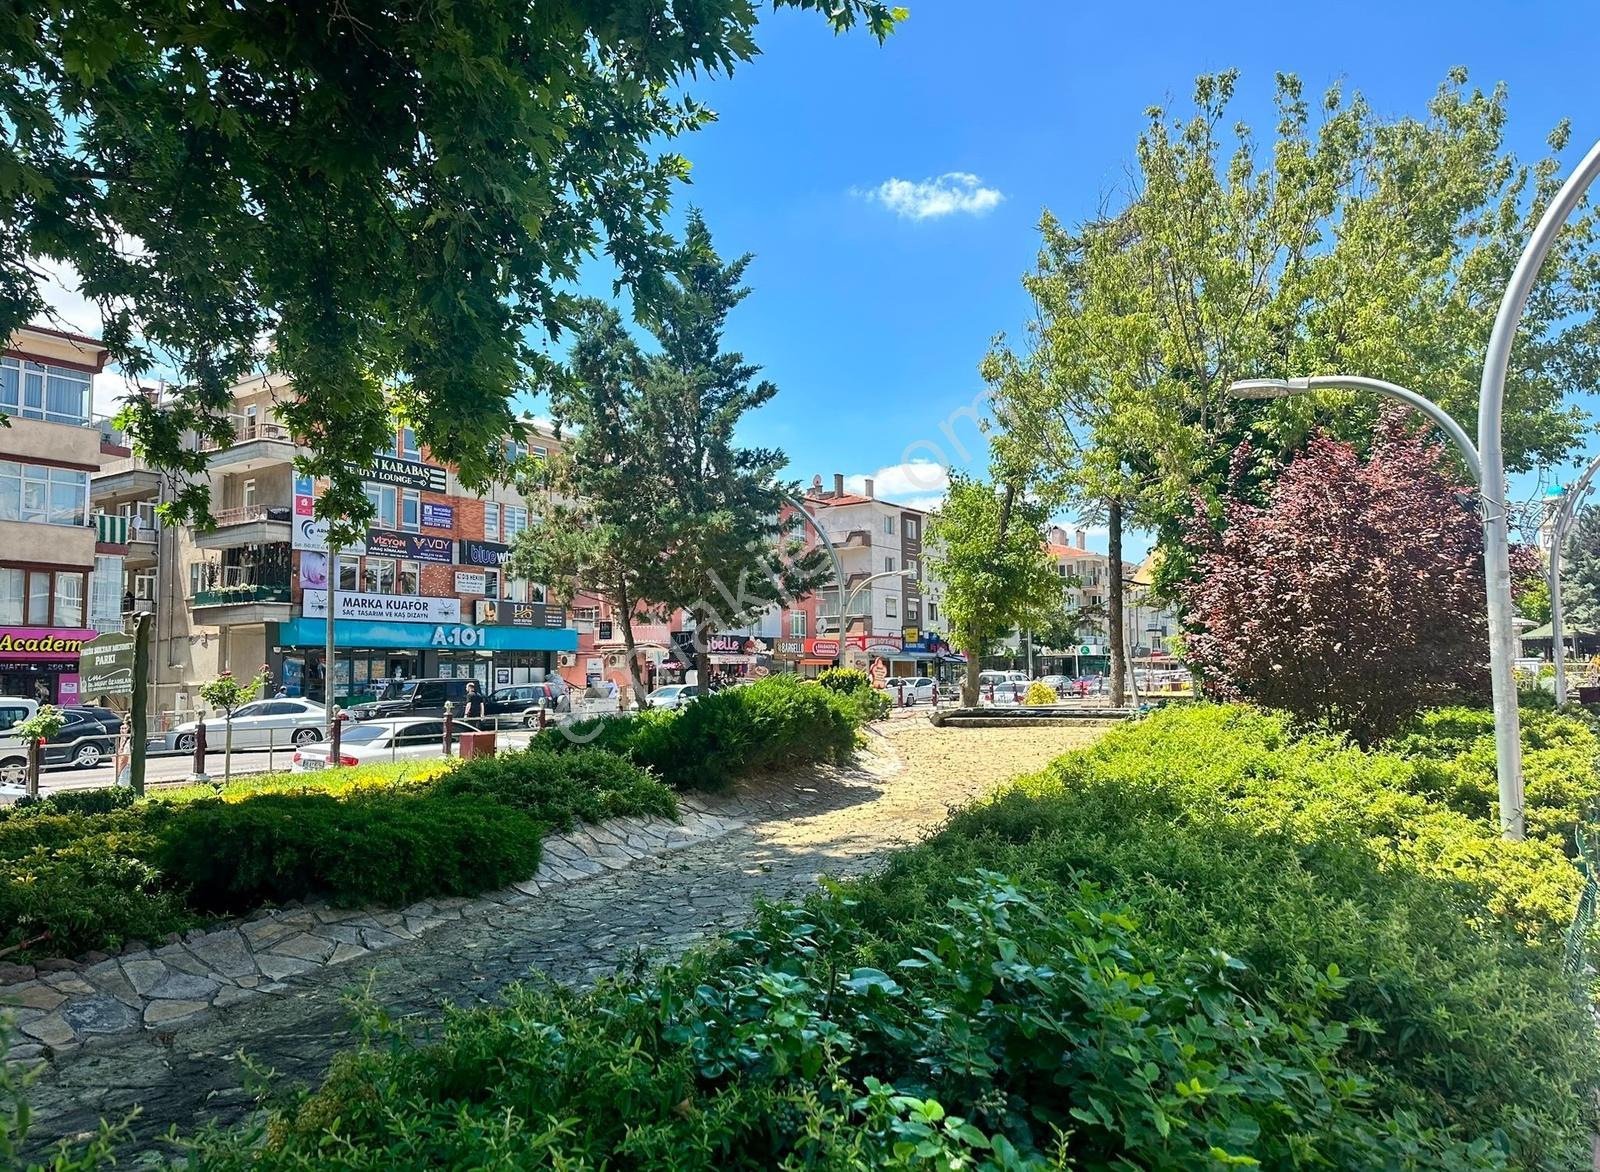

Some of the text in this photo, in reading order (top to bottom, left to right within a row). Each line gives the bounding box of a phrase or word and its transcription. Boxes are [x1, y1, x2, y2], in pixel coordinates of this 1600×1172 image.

[381, 459, 431, 480] KARABAŞ
[379, 472, 413, 485] LOUNGE
[342, 597, 429, 611] MARKA KUAFÖR
[95, 654, 116, 665] PARKI
